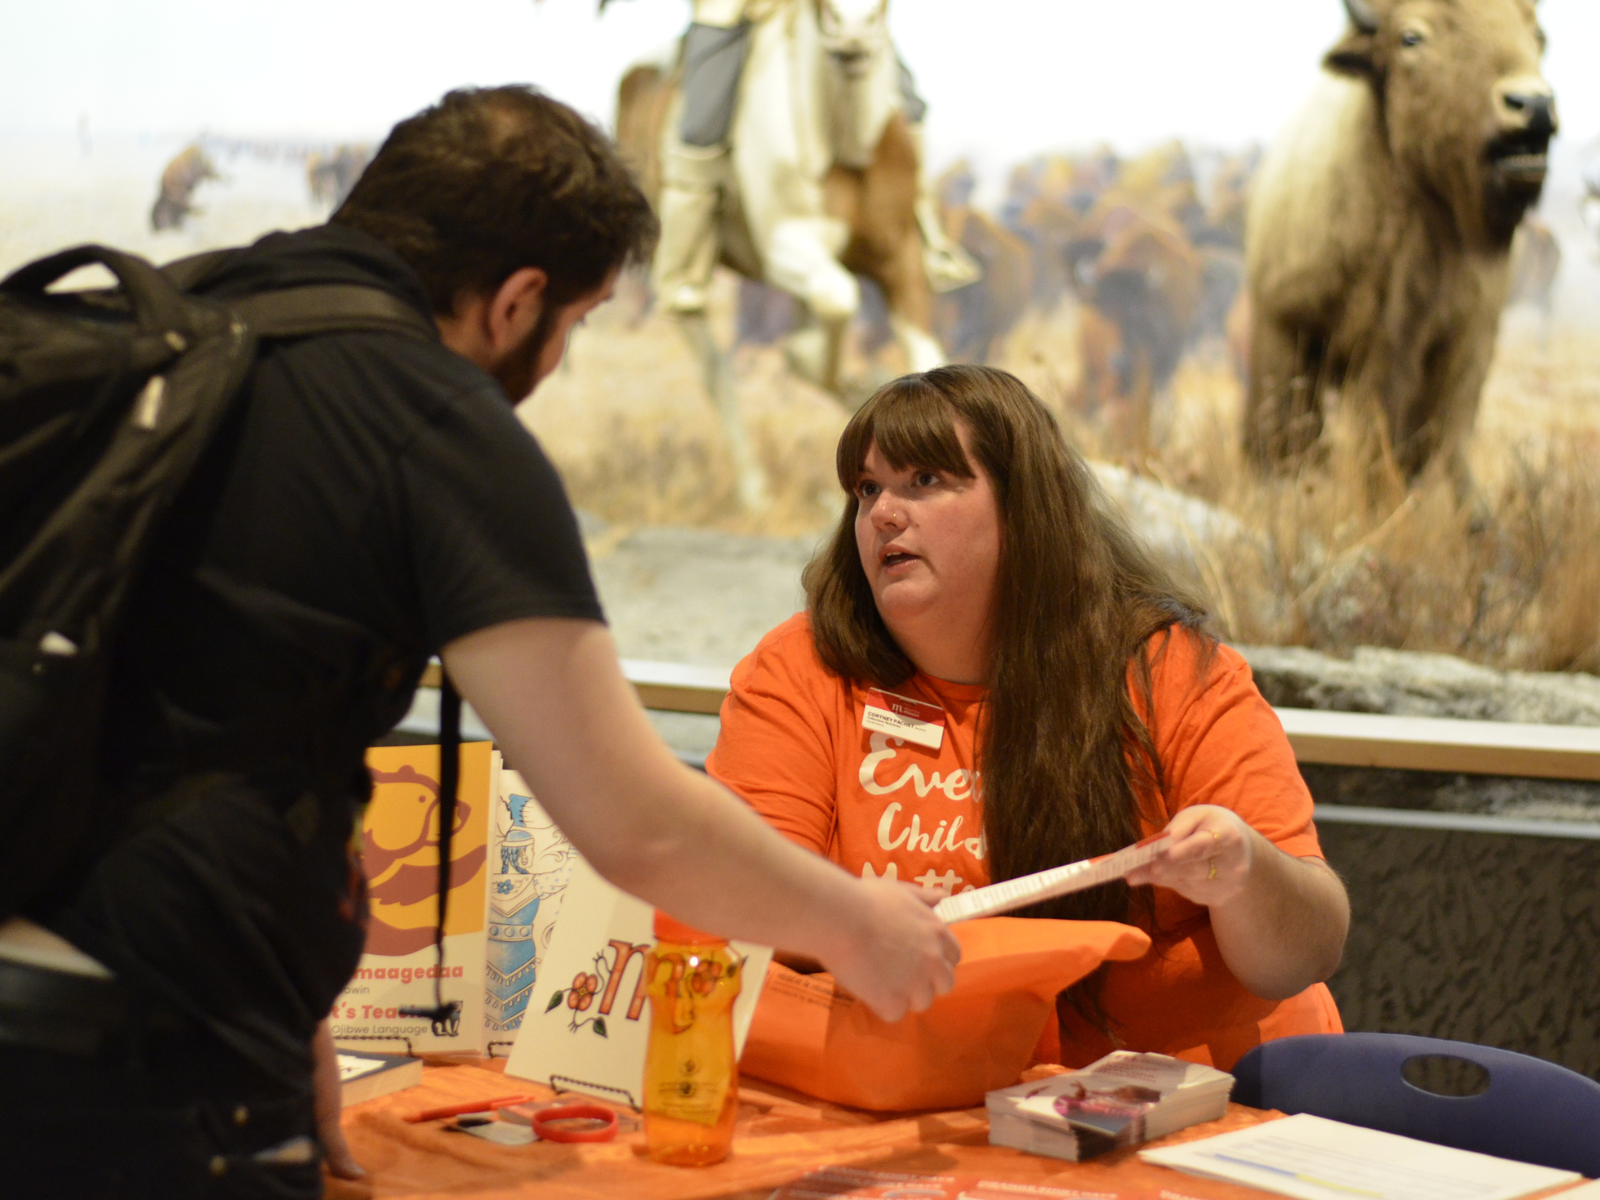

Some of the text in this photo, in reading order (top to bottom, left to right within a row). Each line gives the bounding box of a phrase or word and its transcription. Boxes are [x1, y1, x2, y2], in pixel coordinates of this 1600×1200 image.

[868, 711, 893, 722] CORTNEY
[858, 731, 984, 802] Eve
[332, 1024, 428, 1036] Ojibwe Language
